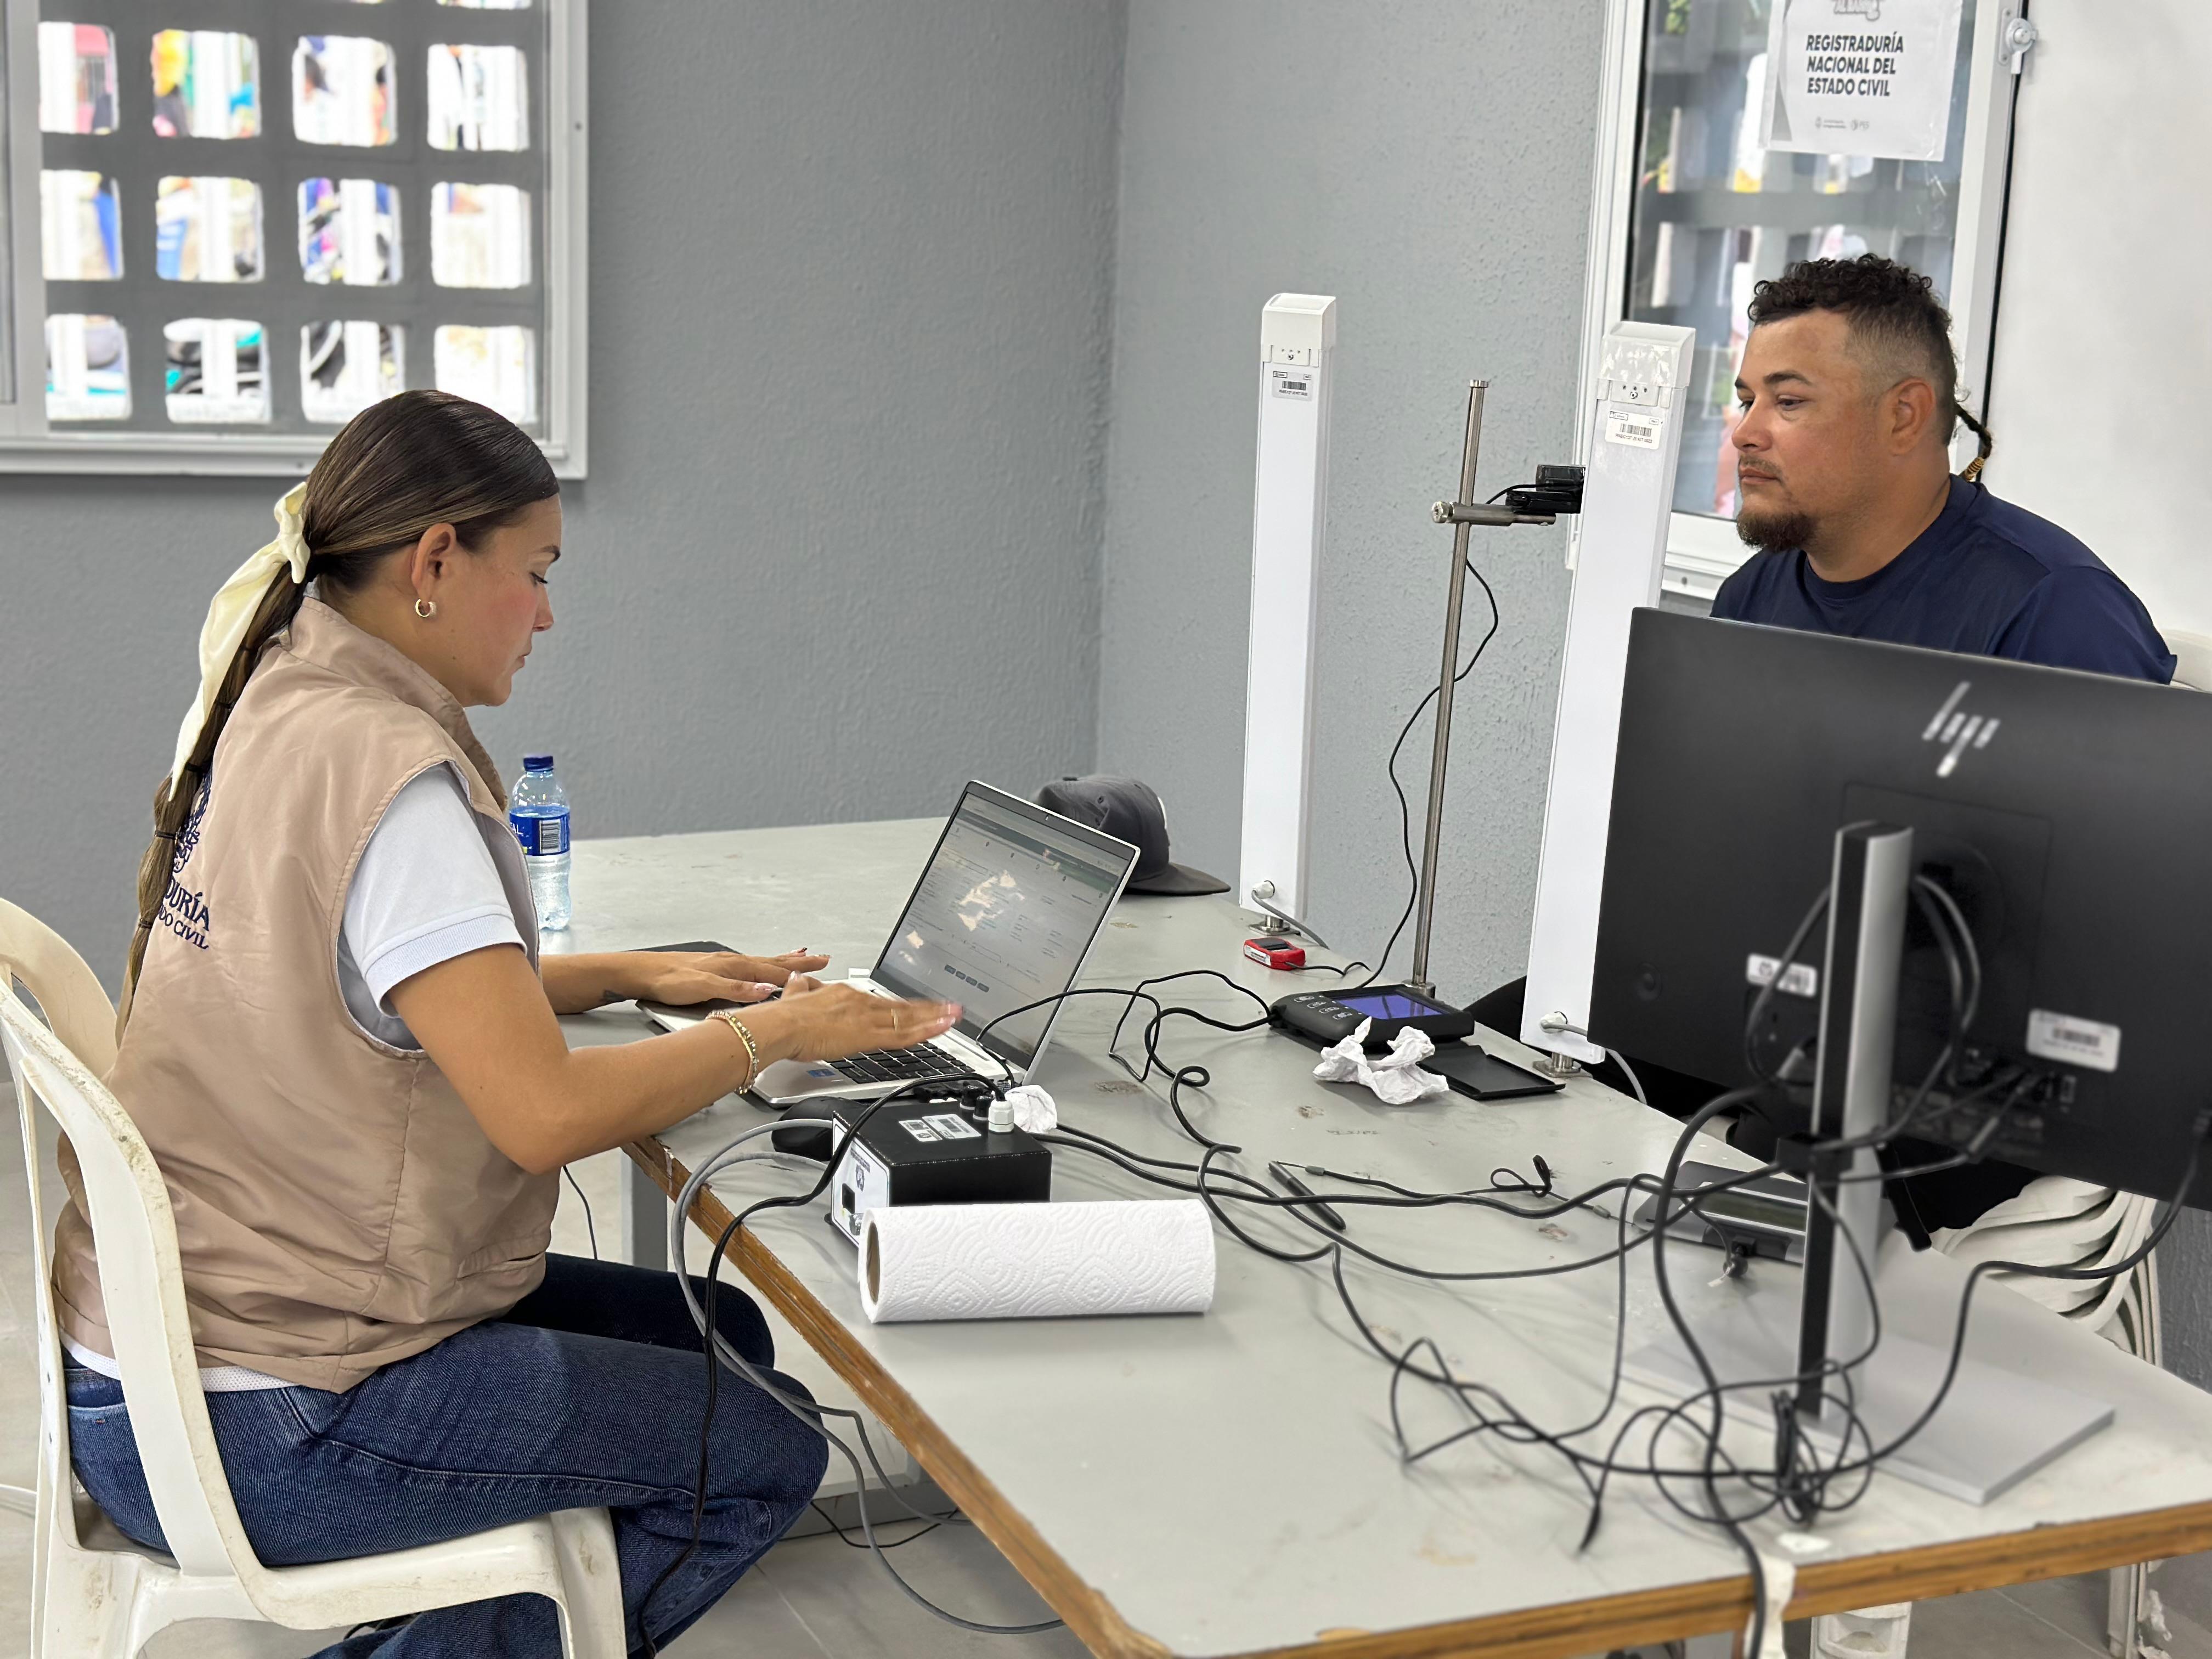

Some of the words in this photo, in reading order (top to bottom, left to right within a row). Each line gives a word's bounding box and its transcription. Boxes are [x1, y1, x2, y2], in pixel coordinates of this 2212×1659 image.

[1805, 31, 1904, 53] REGISTRADURÍA
[1807, 55, 1870, 74] NACIONAL
[1872, 57, 1897, 75] DEL
[1807, 77, 1855, 95] ESTADO
[1858, 78, 1891, 97] CIVIL
[1921, 681, 2001, 778] hp
[165, 876, 210, 932] DURÍA
[158, 904, 173, 927] DO
[173, 920, 210, 950] CIVIL
